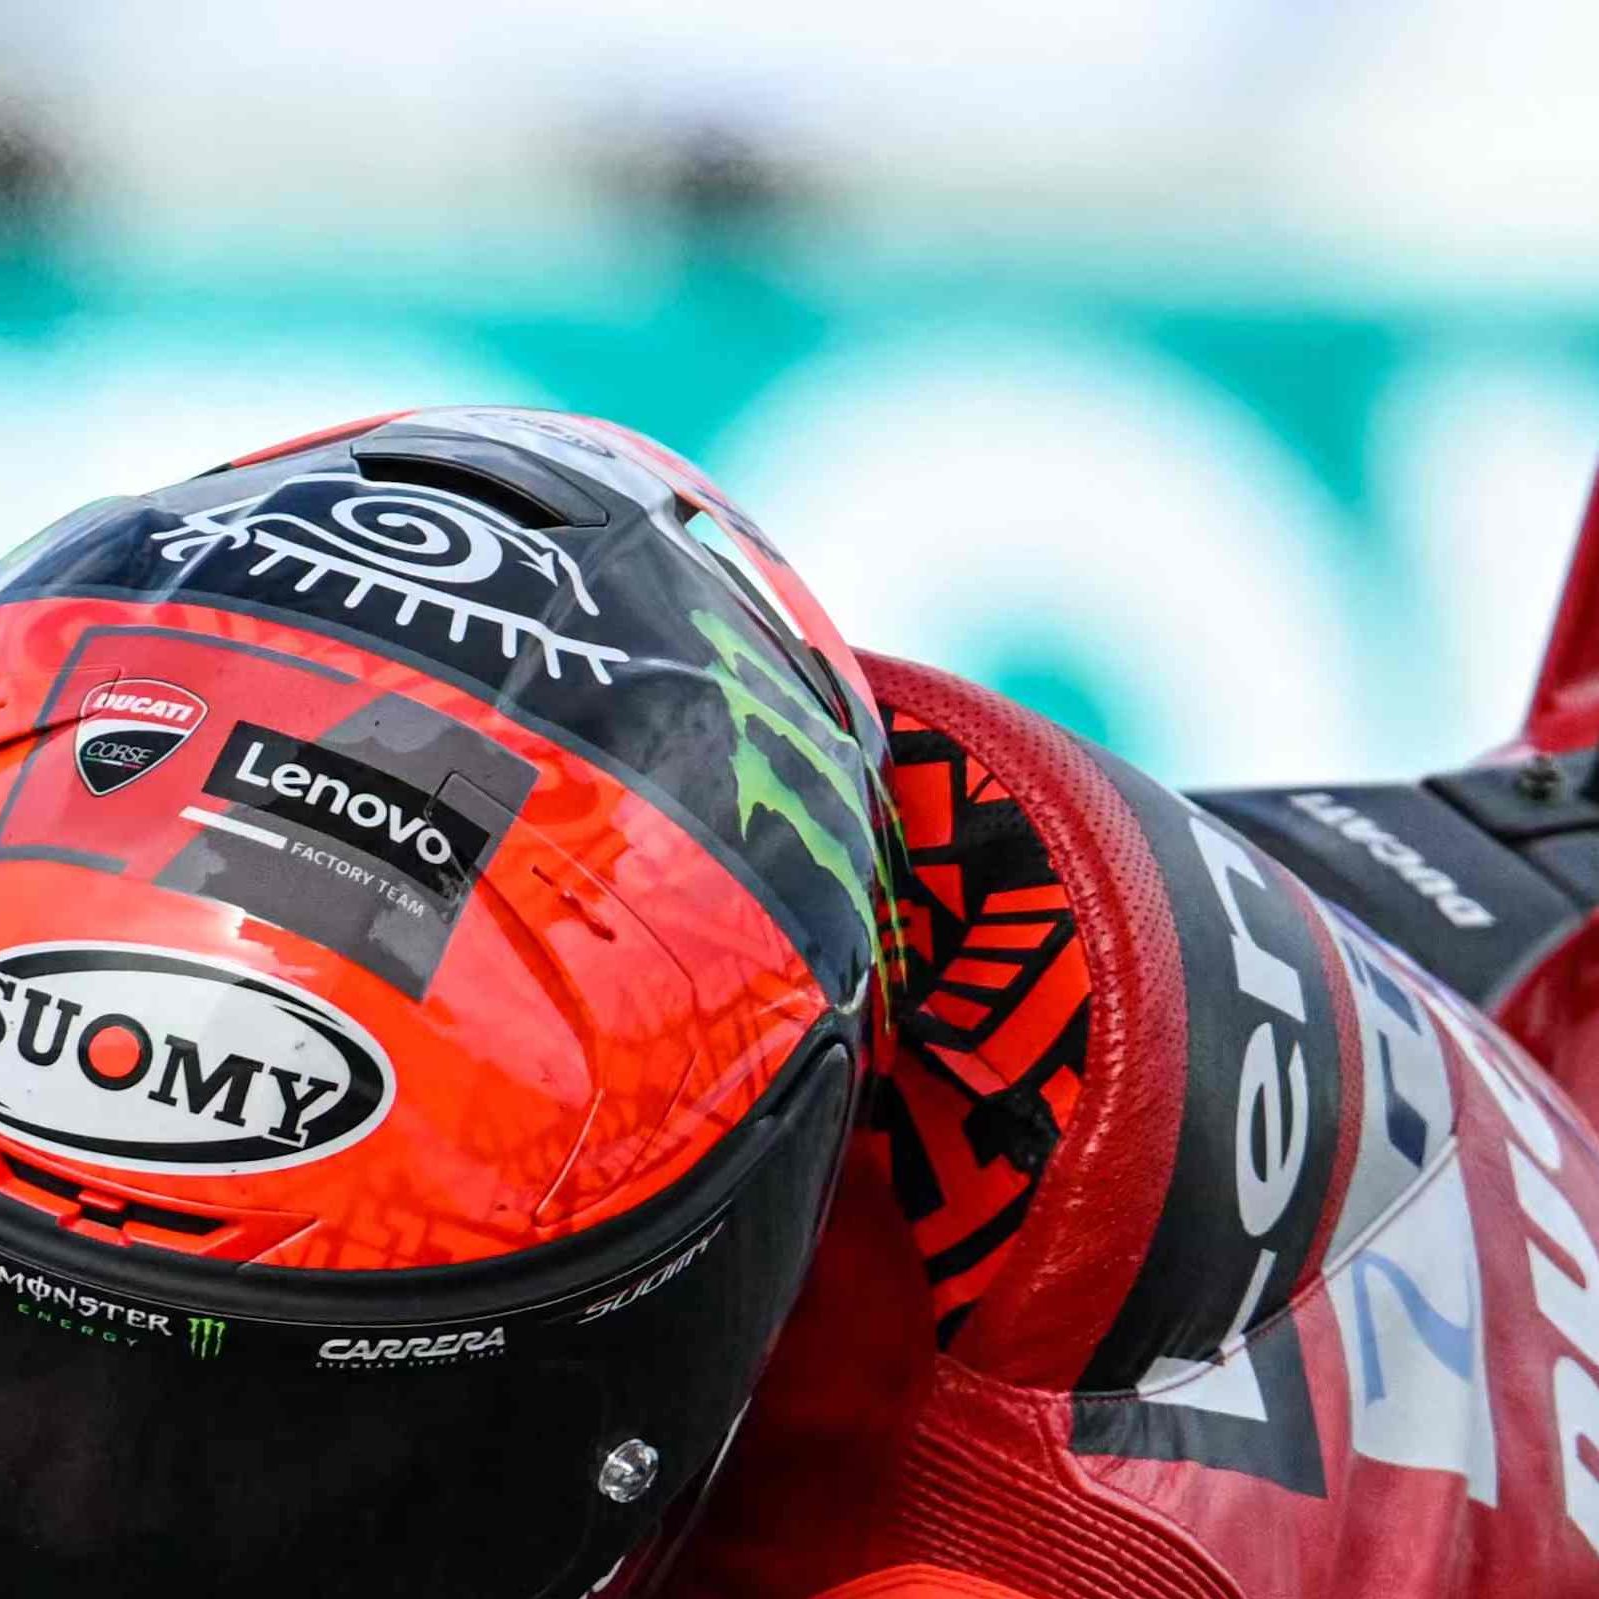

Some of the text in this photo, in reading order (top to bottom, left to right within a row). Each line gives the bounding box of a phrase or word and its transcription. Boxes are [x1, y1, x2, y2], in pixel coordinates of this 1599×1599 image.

[93, 692, 194, 724] DUCATI
[85, 739, 153, 765] CORSE
[235, 740, 452, 865] Lenovo
[290, 841, 426, 918] FACTORY TEAM
[17, 1303, 138, 1348] ENERGY
[319, 1326, 505, 1360] CARRERA
